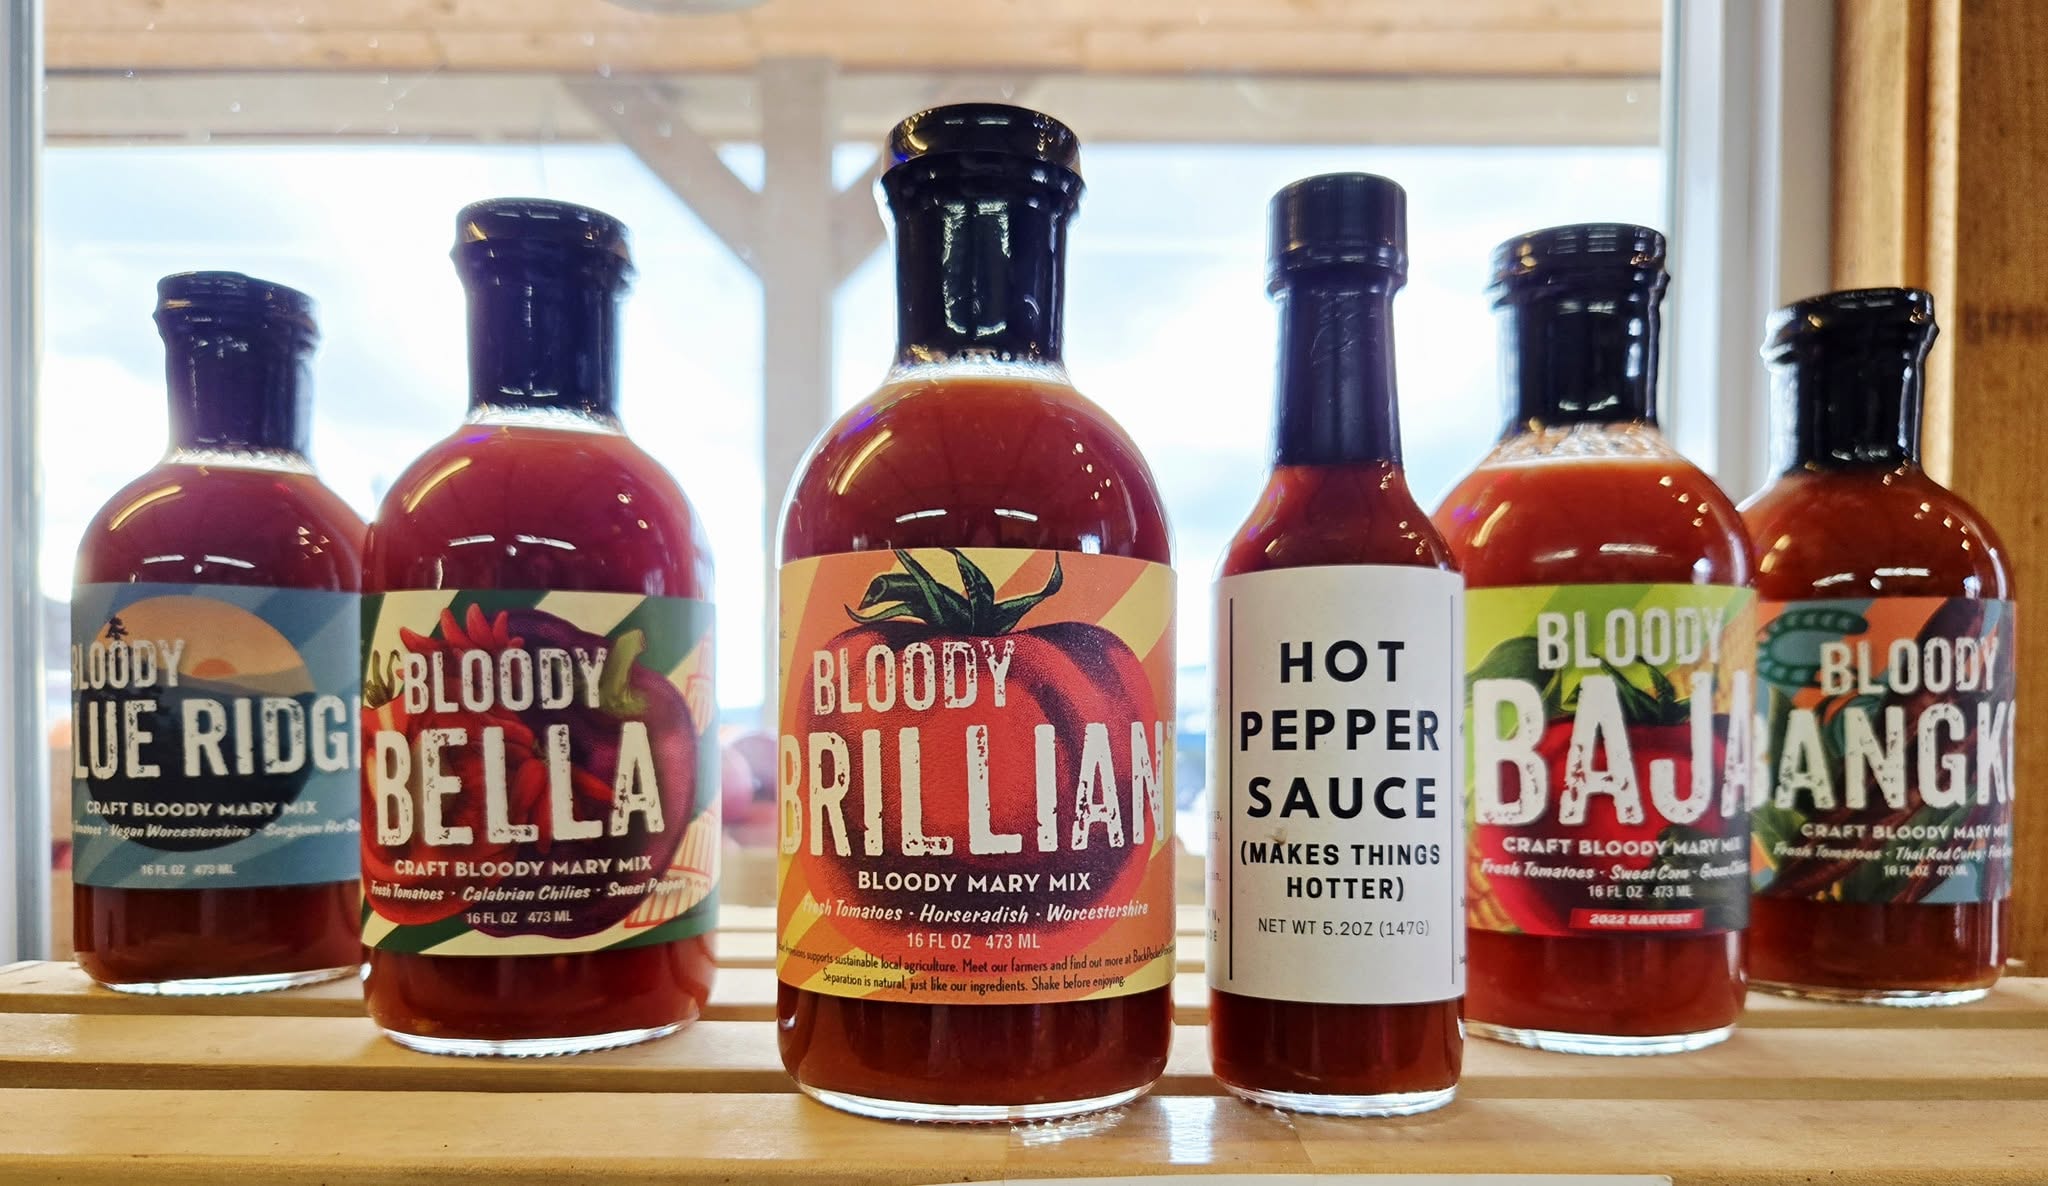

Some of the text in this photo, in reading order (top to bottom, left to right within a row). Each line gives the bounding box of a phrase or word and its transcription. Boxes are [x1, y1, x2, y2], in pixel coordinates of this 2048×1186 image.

[1537, 606, 1724, 670] BLOODY
[72, 638, 185, 690] BLOODY
[1280, 639, 1405, 683] HOT
[1819, 636, 2000, 695] BLOODY
[403, 648, 607, 715] BLOODY
[813, 639, 1016, 715] BLOODY
[72, 698, 162, 779] LUE
[1240, 708, 1440, 751] PEPPER
[1472, 669, 1753, 828] BAJA
[376, 721, 665, 847] BELLA
[86, 800, 319, 817] CRAFT BLOODY MARY MIX
[1246, 776, 1437, 820] SAUCE
[110, 823, 144, 840] Vegan
[146, 824, 252, 838] Worcestershire
[1801, 823, 1867, 839] CRAFT
[1872, 824, 1949, 840] BLOODY
[1953, 823, 1992, 839] MARY
[1240, 840, 1441, 866] (MAKES THINGS
[1501, 836, 1573, 854] CRAFT
[1578, 839, 1667, 856] BLOODY
[1672, 837, 1721, 855] MARY
[1773, 841, 1813, 858] Fresh
[1815, 844, 1882, 860] Tomatoes
[1895, 846, 1926, 861] Thai
[1925, 846, 1952, 861] Red
[141, 864, 154, 876] 16
[155, 864, 169, 876] FL
[169, 863, 187, 876] OZ
[395, 855, 653, 877] CRAFT BLOODY MARY MIX
[1480, 857, 1521, 877] Fresh
[1523, 860, 1596, 880] Tomatoes
[1609, 863, 1657, 881] Sweet
[1657, 863, 1691, 881] Corn
[371, 879, 392, 899] Fresh
[393, 882, 445, 901] Tomatoes
[462, 885, 537, 902] Calabrian
[538, 884, 592, 901] Chilies
[607, 881, 646, 898] Sweet
[858, 870, 1092, 893] BLOODY MARY MIX
[1286, 876, 1405, 902] HOTTER)
[1587, 884, 1696, 898] 16 FL OZ 473 ML
[466, 909, 573, 924] 16 FL OZ 473 ML
[835, 898, 903, 921] Tomatoes
[919, 903, 1029, 924] Horseradish
[1046, 899, 1150, 923] Worcestershire
[1589, 912, 1695, 926] 2022 HARVEST
[1257, 917, 1287, 934] NET
[1291, 919, 1317, 935] WT
[1378, 919, 1431, 938] (147G)
[907, 932, 1041, 949] 16 FL OZ 473 ML
[806, 951, 833, 966] supports
[835, 951, 878, 969] sustainable
[881, 955, 902, 970] local
[904, 958, 959, 975] agriculture.
[962, 958, 988, 973] Meet
[991, 961, 1008, 973] our
[1011, 957, 1048, 973] farmers
[1050, 957, 1068, 971] and
[1070, 954, 1087, 970] find
[1088, 954, 1103, 968] out
[1104, 954, 1123, 967] more
[1124, 952, 1133, 965] at
[823, 967, 1126, 996] Separation is natural, just like our ingredients. Shake before enjoying.
